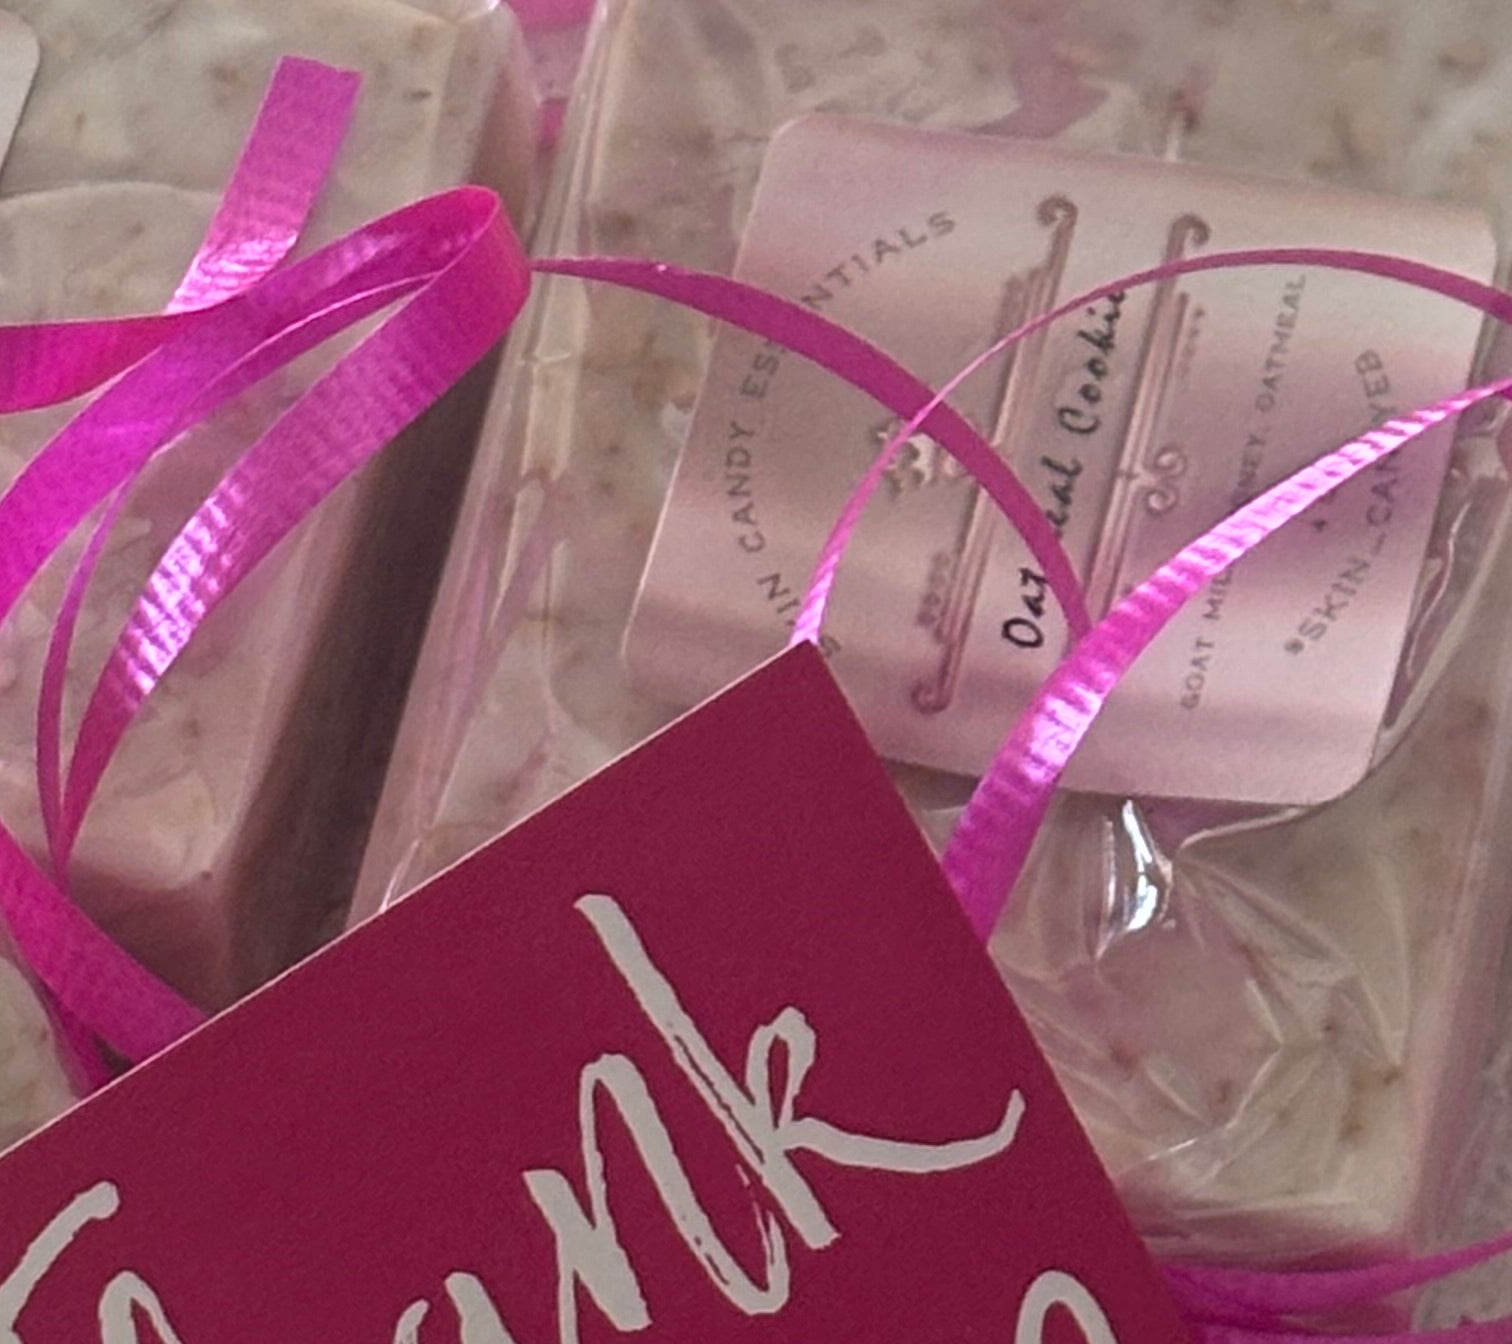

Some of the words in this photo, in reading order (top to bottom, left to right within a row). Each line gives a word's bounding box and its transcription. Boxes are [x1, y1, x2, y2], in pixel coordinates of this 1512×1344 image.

[739, 210, 958, 401] ESNTIALS
[726, 420, 767, 555] CANDY
[1000, 455, 1084, 649] Oateal
[1056, 289, 1128, 437] Cookie
[1181, 637, 1216, 711] GOAT
[1252, 273, 1307, 415] OATMEAL
